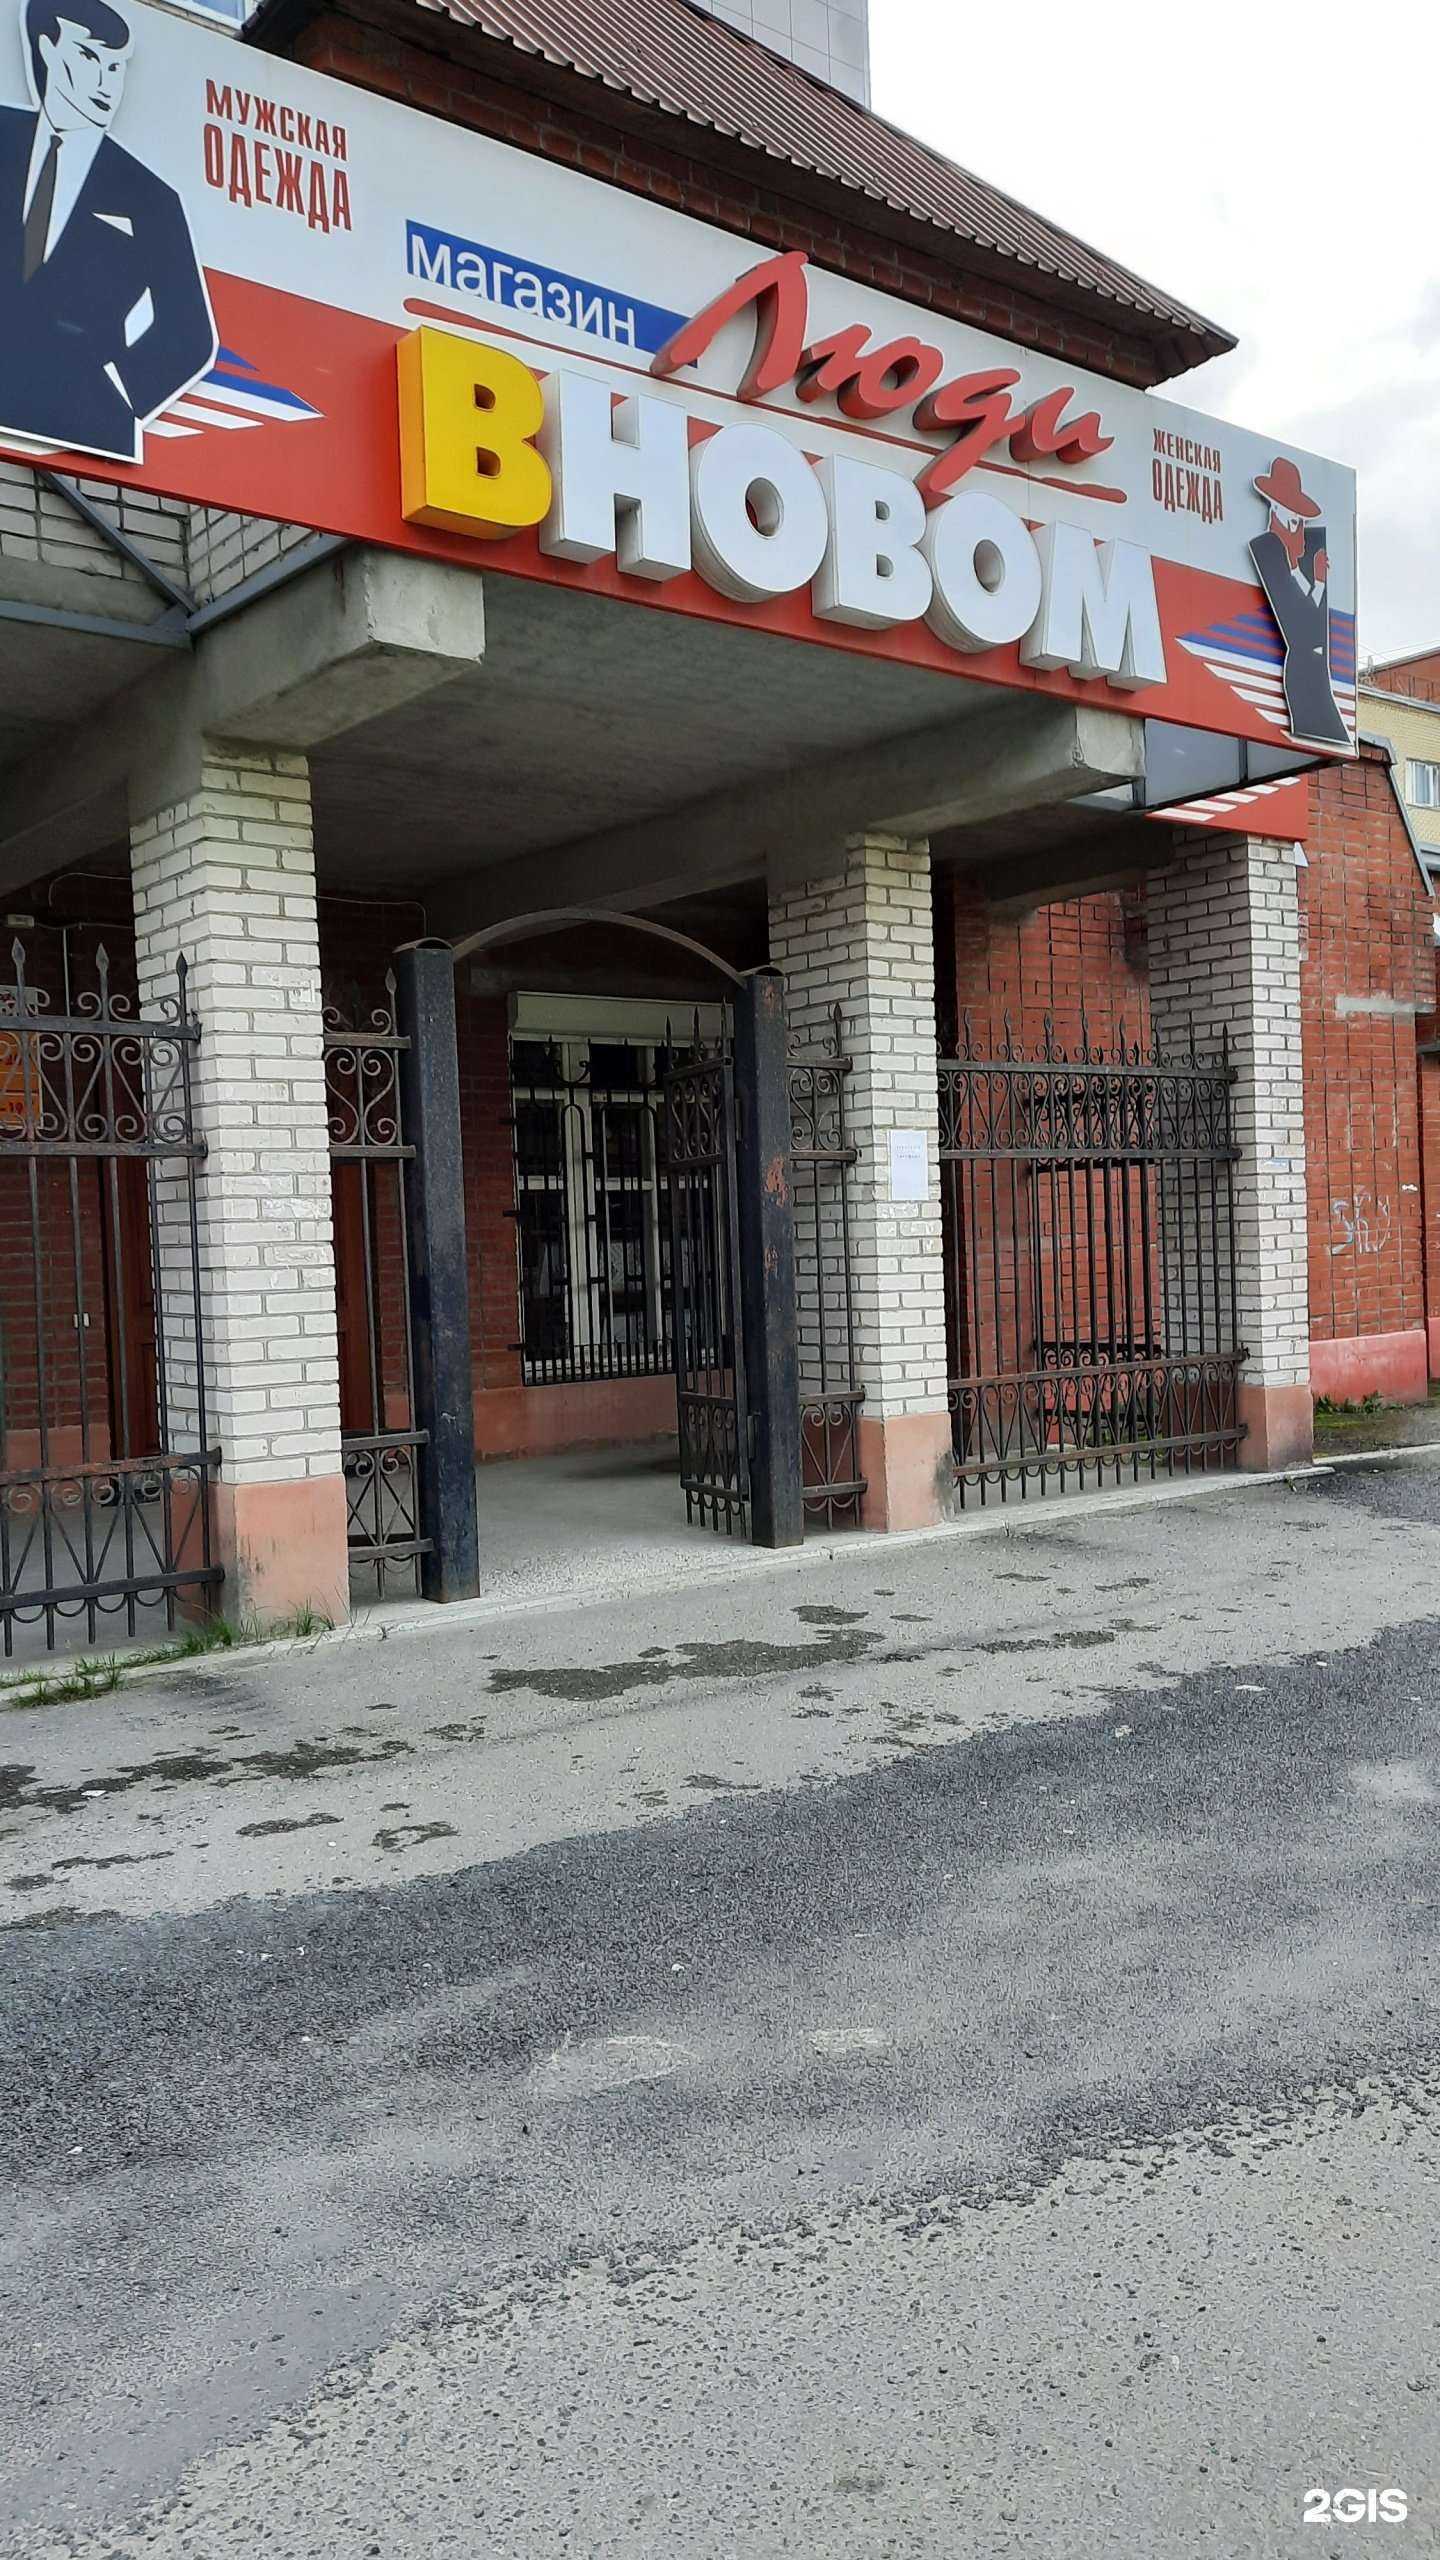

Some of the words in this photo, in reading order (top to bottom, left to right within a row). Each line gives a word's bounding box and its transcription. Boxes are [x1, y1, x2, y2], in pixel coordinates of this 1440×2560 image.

[206, 78, 348, 162] МУЖСКАЯ
[203, 122, 352, 234] ОДЕЖДА
[411, 234, 636, 347] магазин
[649, 252, 1115, 495] Люди
[1152, 458, 1223, 524] ОДЕЖДА
[1153, 428, 1221, 473] ЖЕНСКАЯ
